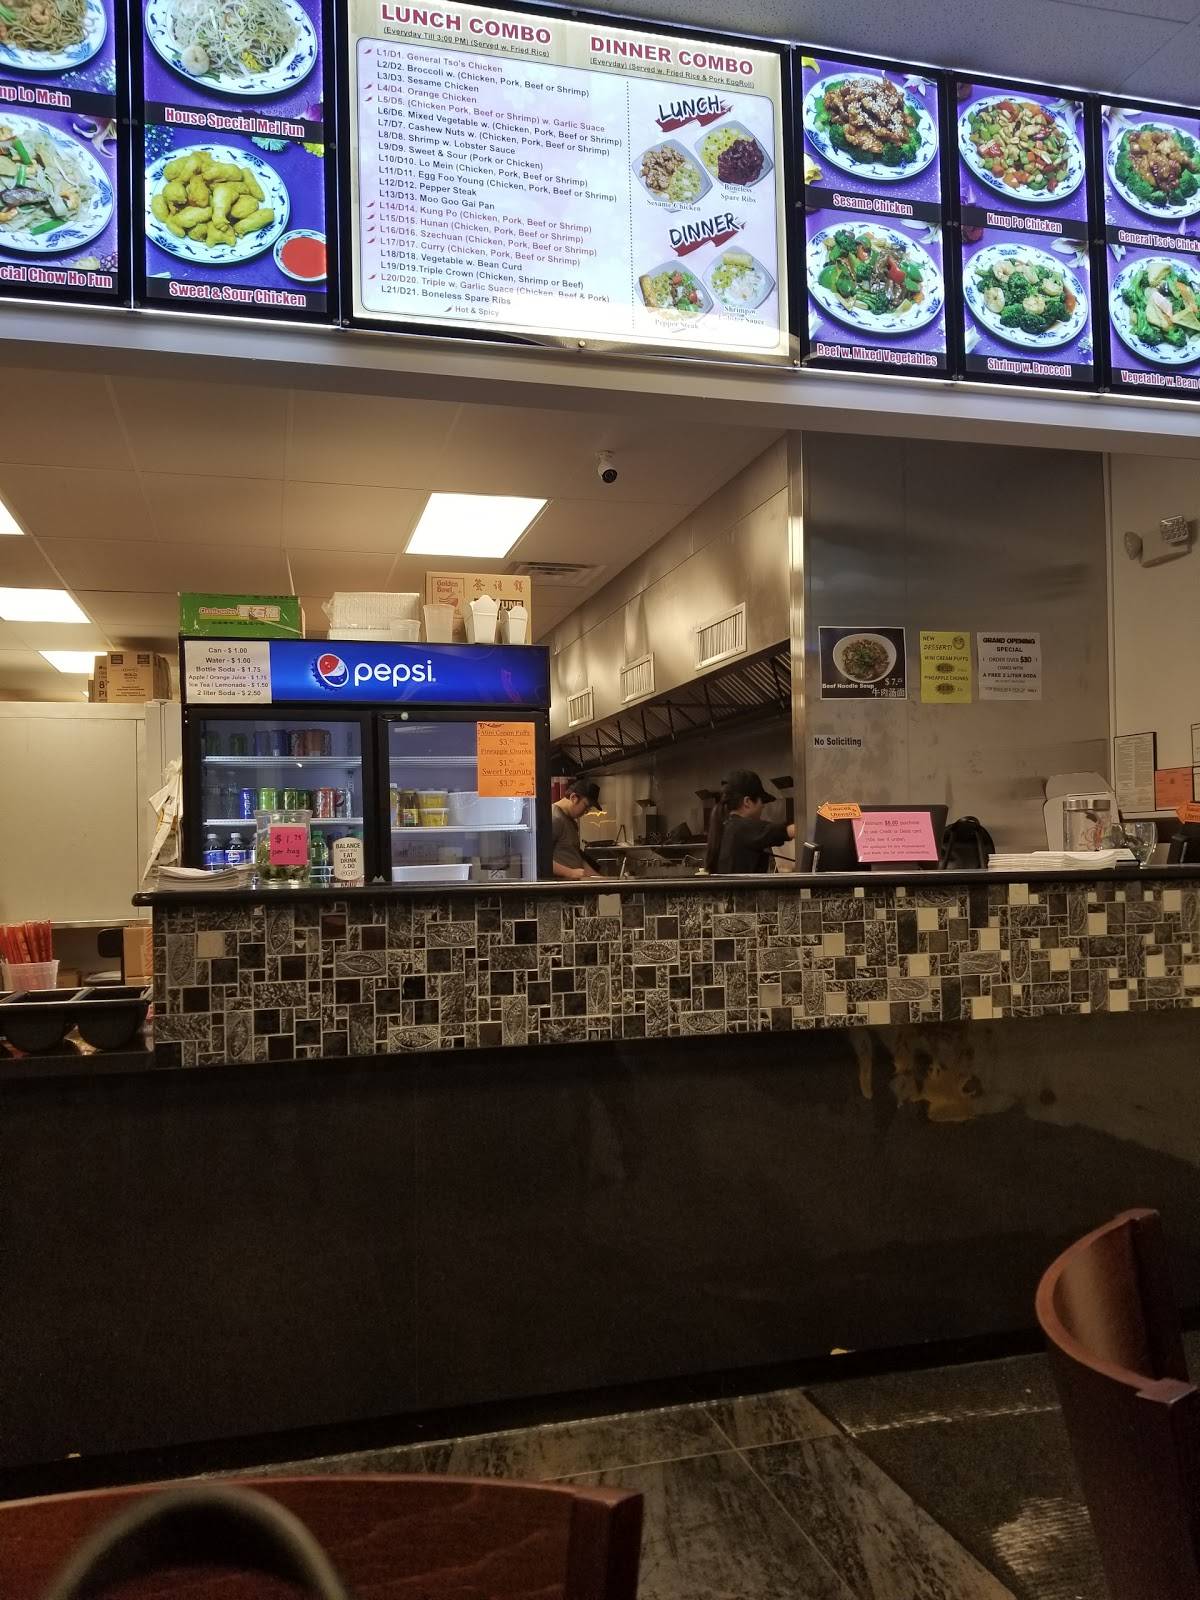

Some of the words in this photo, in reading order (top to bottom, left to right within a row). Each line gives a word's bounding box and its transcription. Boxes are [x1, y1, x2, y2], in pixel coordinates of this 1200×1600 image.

[382, 5, 460, 30] LUNCH
[470, 19, 550, 43] COMBO
[384, 27, 423, 39] (Everyday
[436, 35, 454, 44] 3:00
[470, 40, 500, 50] (Served
[510, 45, 530, 55] Fried
[530, 48, 549, 58] Rice)
[592, 37, 671, 63] DINNER
[679, 51, 752, 75] COMBO
[377, 60, 404, 71] L2/D2.
[408, 65, 443, 76] Broccoli
[458, 72, 497, 85] (Chicken,
[500, 78, 522, 88] Pork,
[525, 81, 543, 90] Beef
[557, 86, 589, 98] Shrimp)
[378, 72, 404, 82] L3/D3.
[408, 76, 441, 87] Sesame
[445, 82, 478, 92] Chicken
[590, 58, 628, 70] (Everyday)
[628, 64, 656, 74] (Served
[666, 69, 685, 78] Fried
[685, 72, 702, 81] Rice
[708, 76, 725, 84] Pork
[18, 86, 35, 102] Lo
[36, 89, 71, 108] Mein
[658, 94, 721, 121] LUNCH
[165, 107, 206, 126] House
[207, 113, 256, 132] Special
[257, 119, 280, 135] Mei
[282, 122, 304, 138] Fun
[378, 107, 405, 117] L6/D6.
[408, 111, 434, 121] Mixed
[436, 115, 478, 127] Vegetable
[493, 122, 531, 135] (Chicken,
[535, 128, 556, 138] Pork,
[559, 131, 577, 140] Beef
[591, 135, 622, 147] Shrimp)
[378, 130, 405, 140] L8/D8.
[409, 135, 440, 146] Shrimp
[455, 140, 487, 150] Lobster
[490, 145, 515, 154] Sauce
[379, 142, 406, 152] L9/D9.
[409, 146, 435, 156] Sweet
[447, 151, 467, 159] Sour
[470, 154, 492, 163] (Pork
[506, 159, 543, 171] Chicken)
[380, 178, 416, 189] L12/D12.
[420, 181, 450, 193] Pepper
[453, 187, 476, 196] Steak
[380, 189, 417, 200] L13/D13.
[420, 194, 438, 203] Moo
[441, 197, 459, 205] Goo
[479, 201, 494, 210] Pan
[833, 194, 872, 210] Sesame
[873, 199, 913, 216] Chicken
[669, 212, 740, 246] DINNER
[987, 213, 1011, 228] Kung
[1012, 216, 1024, 228] Po
[1025, 218, 1062, 233] Chicken
[1119, 230, 1152, 246] General
[1152, 235, 1176, 248] Tso's
[381, 250, 418, 260] L18/D18.
[421, 254, 463, 265] Vegetable
[478, 260, 499, 268] Bean
[502, 262, 522, 271] Curd
[28, 268, 67, 285] Chow
[67, 271, 86, 286] Ho
[88, 272, 112, 288] Fun
[169, 282, 210, 299] Sweet
[211, 287, 221, 300] &
[221, 286, 253, 302] Sour
[253, 289, 306, 307] Chicken
[382, 285, 419, 295] L21/D21.
[465, 294, 490, 303] Spare
[816, 343, 841, 358] Beef
[841, 347, 852, 359] w.
[852, 347, 882, 362] Mixed
[882, 350, 937, 367] Vegetables
[988, 358, 1020, 374] Shrimp
[1020, 363, 1032, 374] w.
[1032, 362, 1072, 377] Broccoli
[1121, 370, 1165, 386] Vegetable
[1165, 376, 1176, 387] w.
[1176, 376, 1198, 389] Bean
[354, 659, 432, 687] pepsi
[814, 738, 824, 746] No
[827, 737, 862, 747] Soliciting
